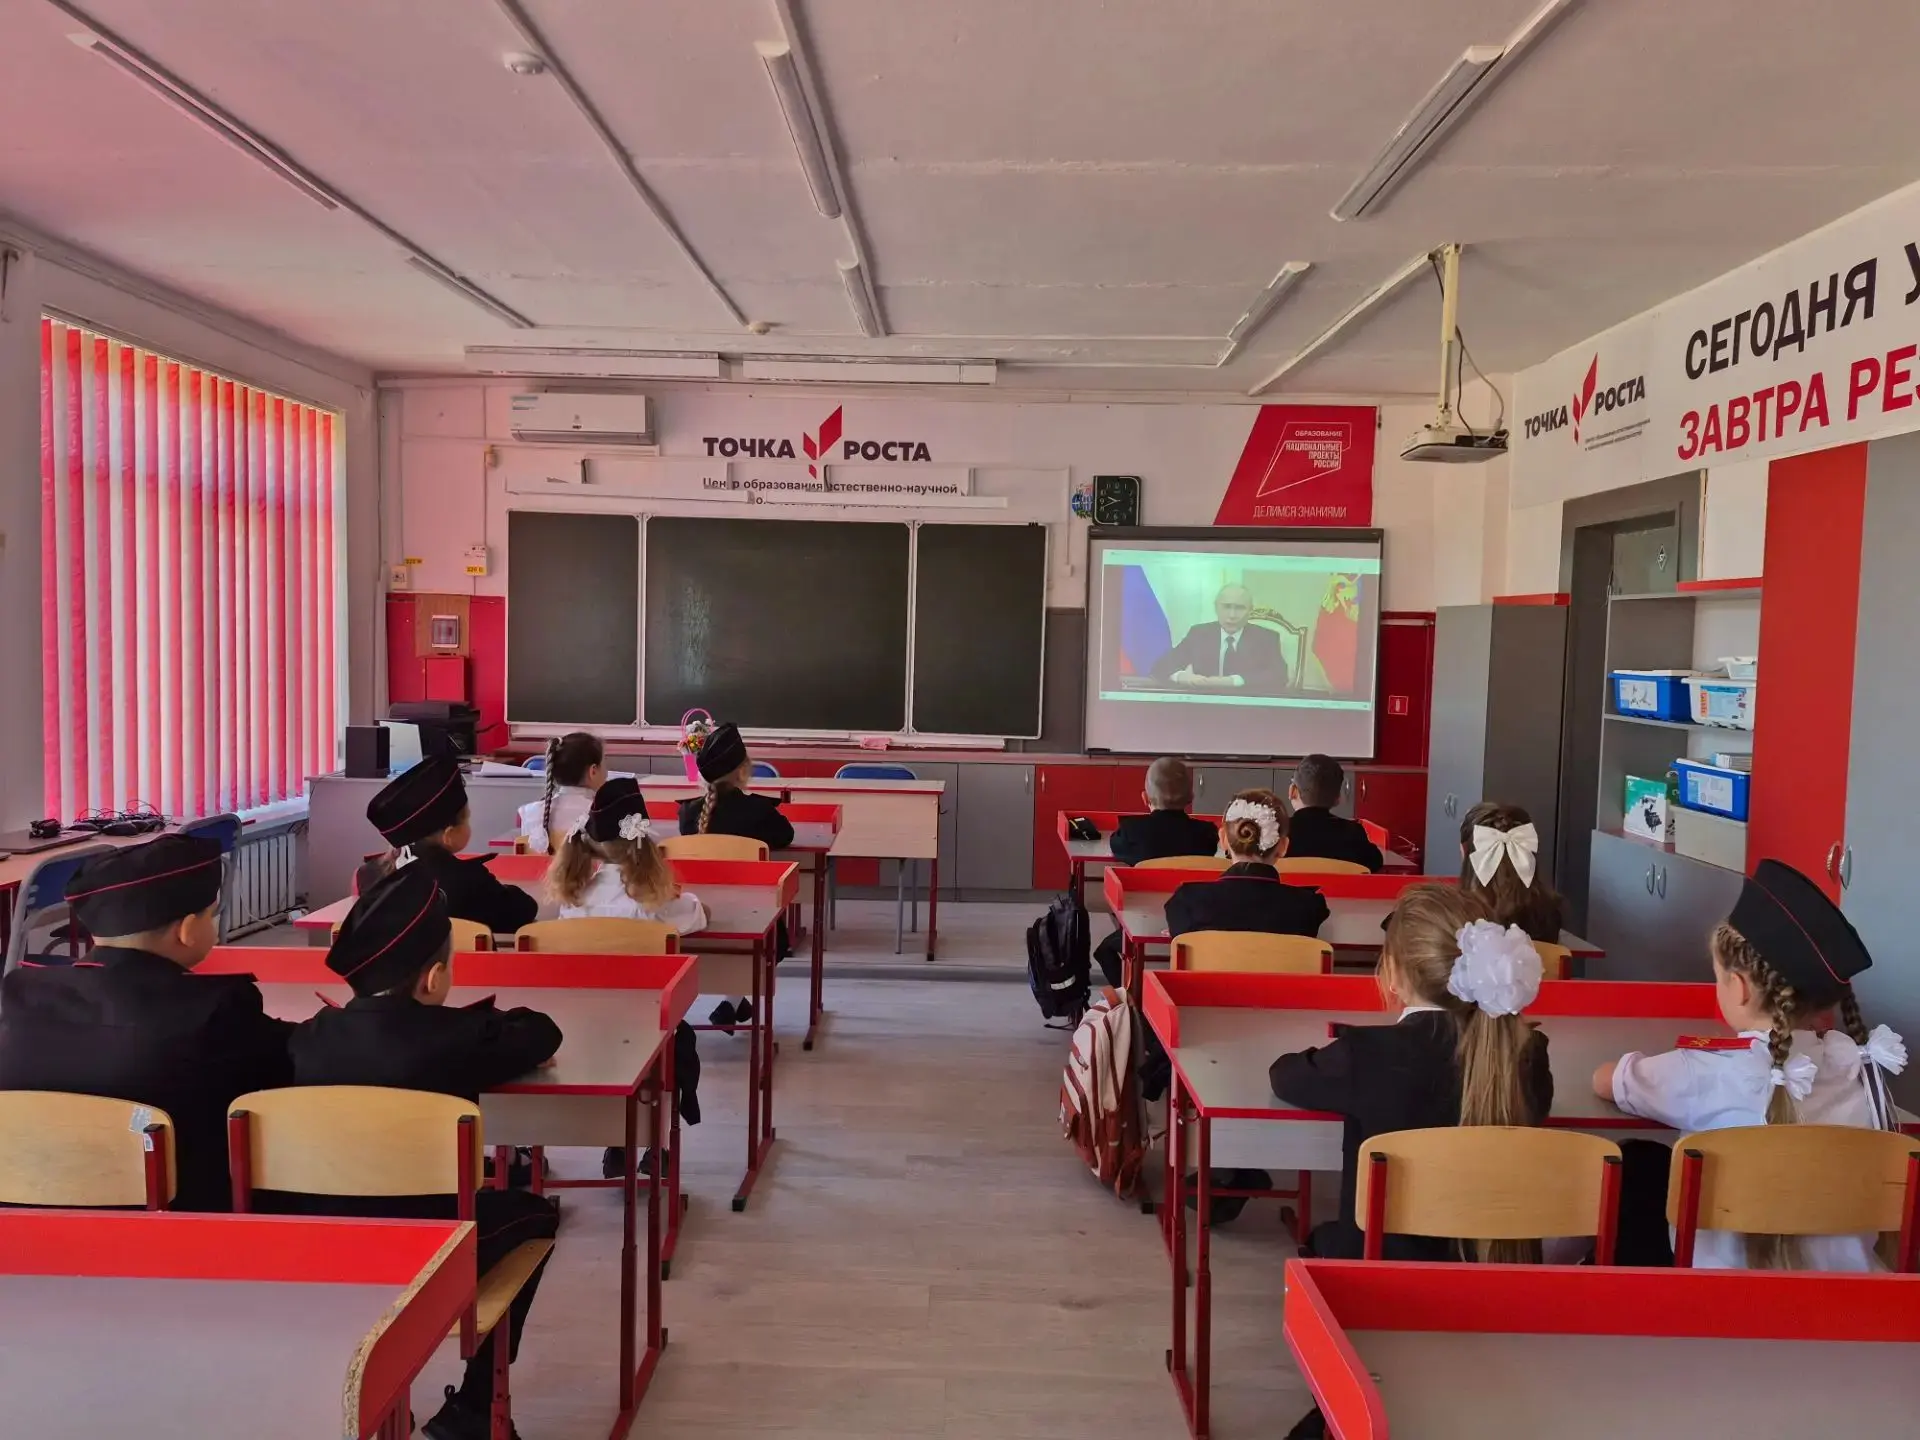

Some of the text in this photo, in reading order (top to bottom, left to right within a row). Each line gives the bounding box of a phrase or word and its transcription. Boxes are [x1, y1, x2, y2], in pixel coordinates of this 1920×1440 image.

[1685, 256, 1878, 380] СЕГОДНЯ
[1524, 404, 1569, 440] ТОЧКА
[1594, 375, 1646, 416] РОСТА
[1677, 343, 1920, 461] ЗАВТРА РЕ
[702, 437, 932, 462] ТОЧКА РОСТА
[1286, 442, 1340, 451] НАЦИОНАЛЬНЫЕ
[1309, 451, 1340, 460] ПРОЕКТЫ
[1313, 459, 1340, 469] РОССИИ
[703, 477, 740, 491] Ценр
[743, 479, 823, 493] образования
[1253, 505, 1347, 519] ДЕЛИМСЯ ЗНАНИЯМИ
